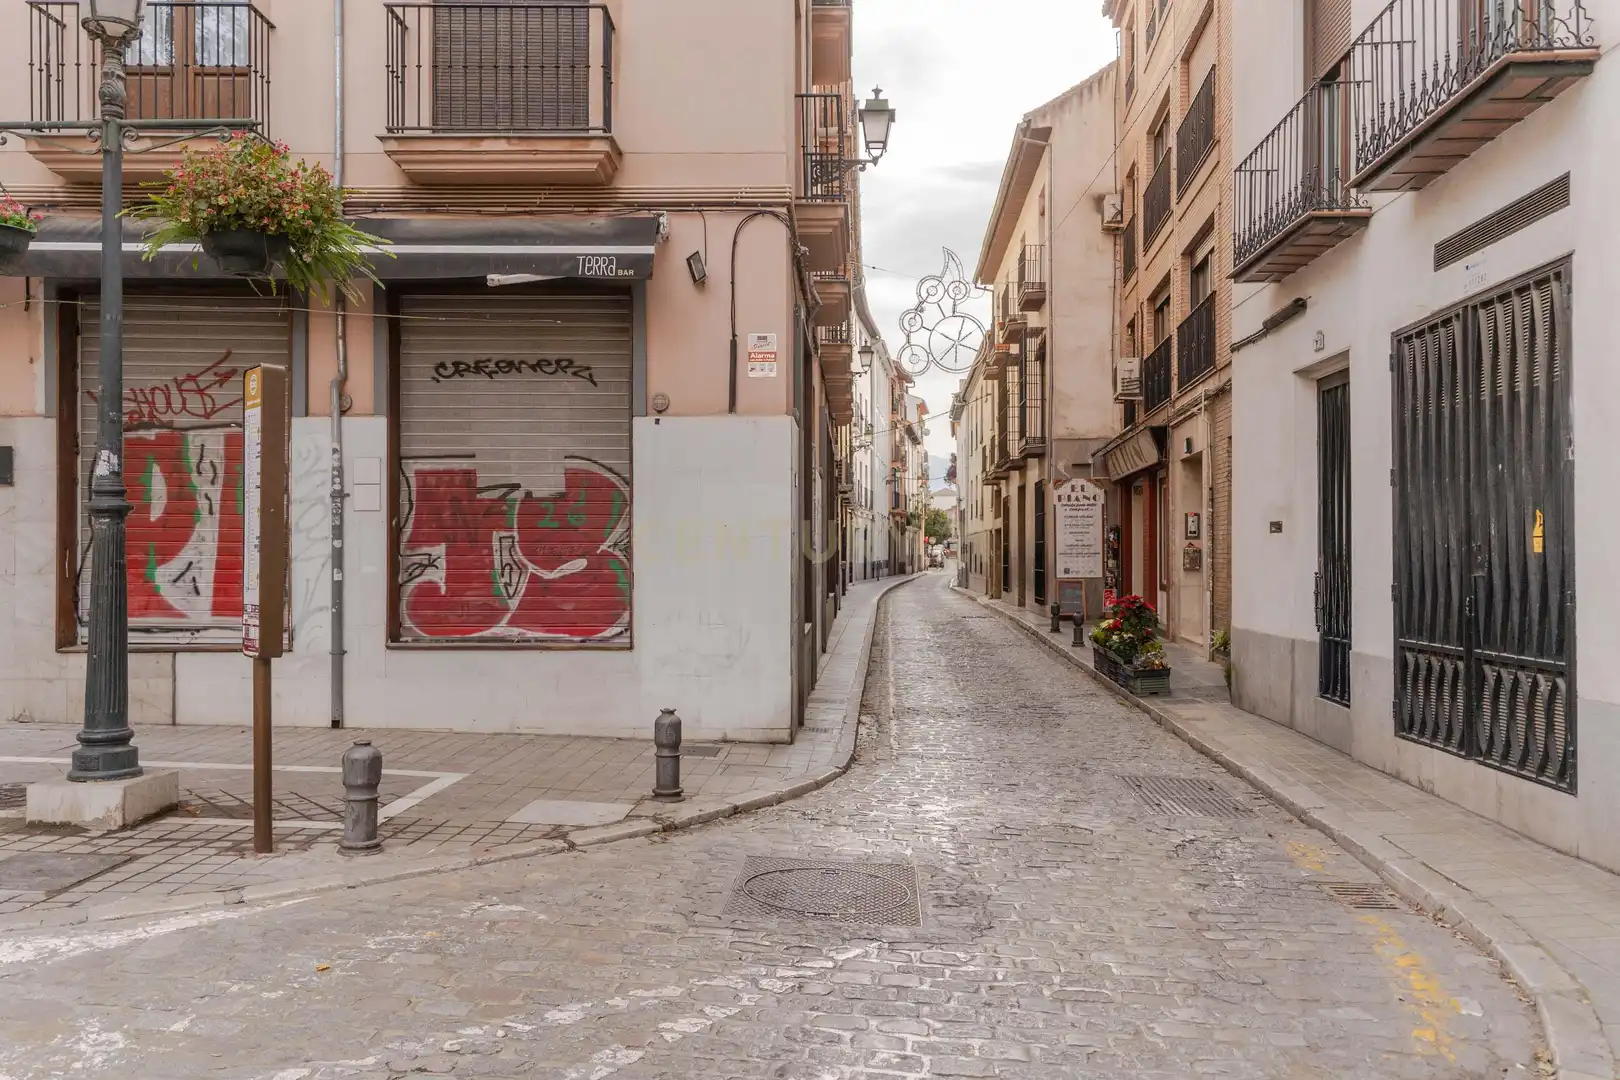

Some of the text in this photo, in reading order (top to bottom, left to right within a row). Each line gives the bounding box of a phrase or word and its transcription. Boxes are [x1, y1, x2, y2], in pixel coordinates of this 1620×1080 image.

[617, 268, 635, 276] BAR
[1070, 484, 1087, 493] EL
[1057, 494, 1101, 503] PIANO
